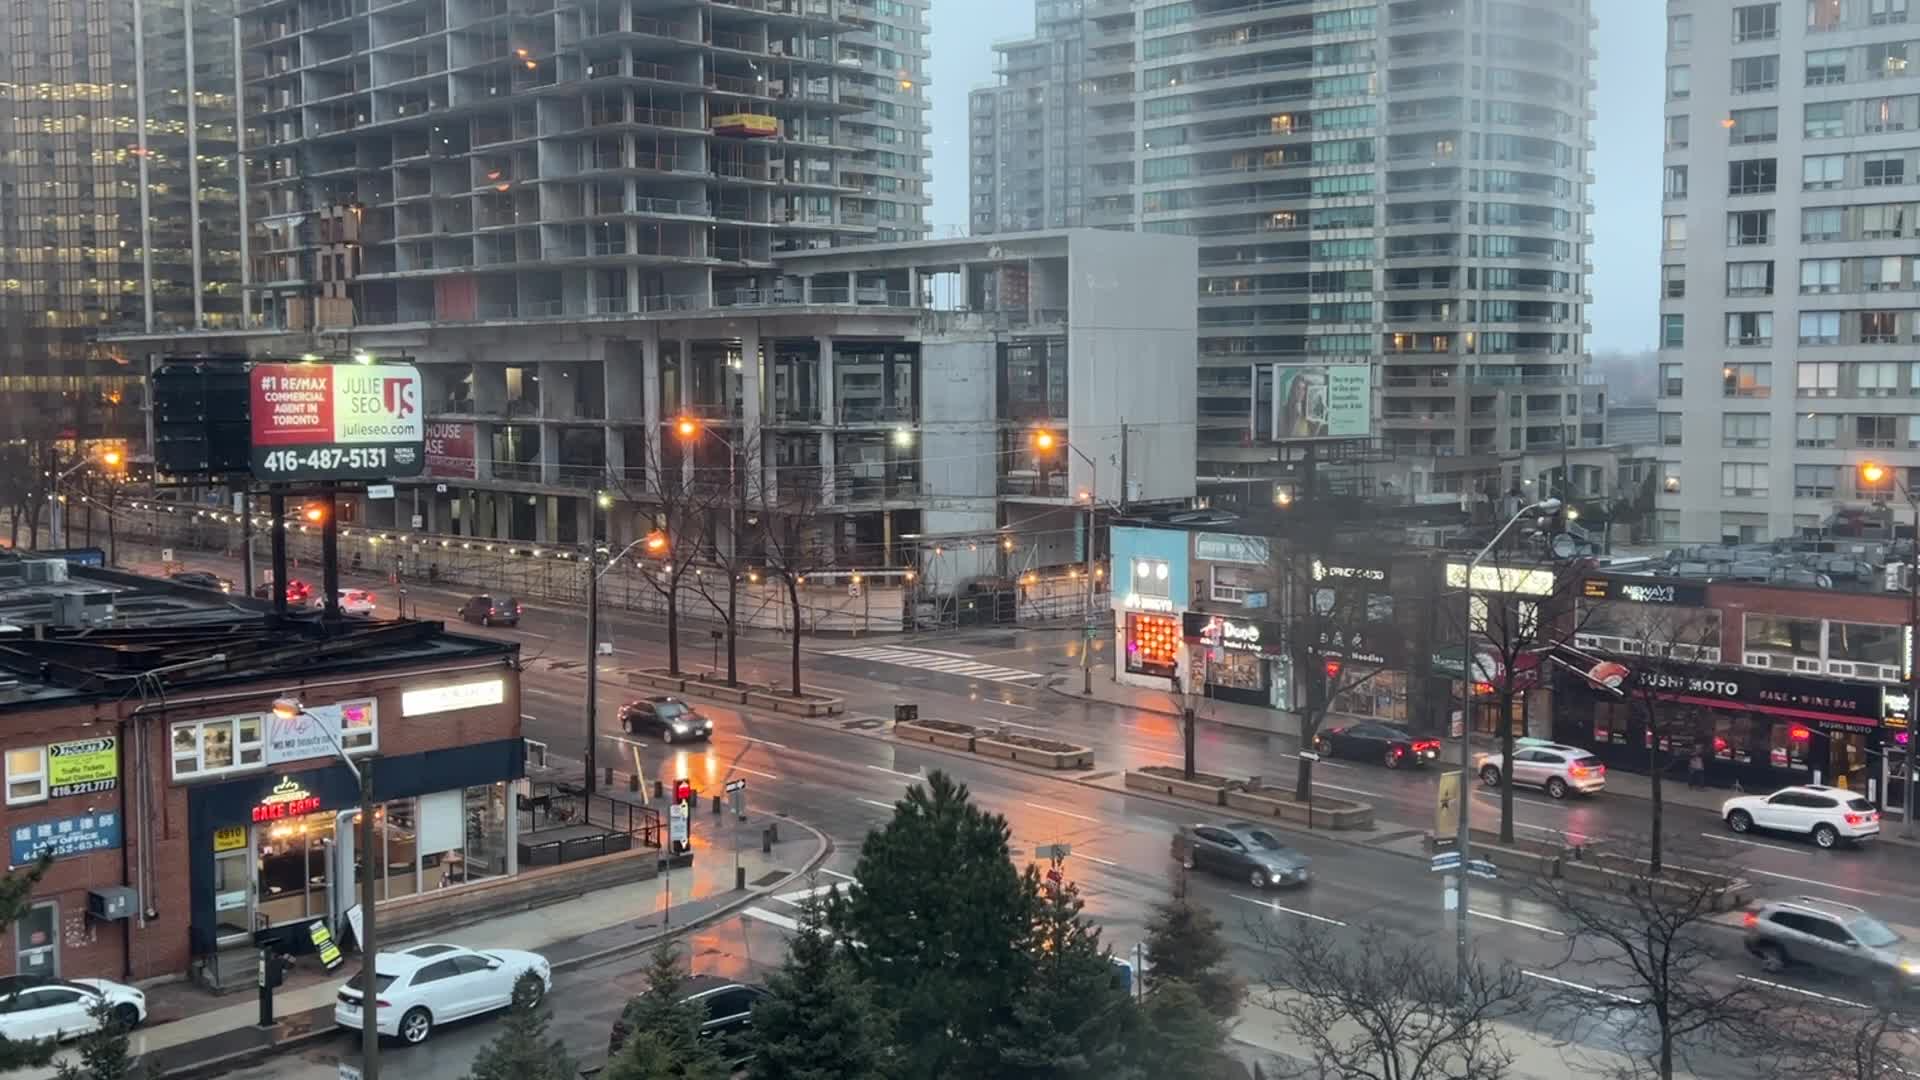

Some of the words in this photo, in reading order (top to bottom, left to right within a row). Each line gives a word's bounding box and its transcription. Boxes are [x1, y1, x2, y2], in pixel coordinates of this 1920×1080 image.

[261, 376, 276, 390] #1
[281, 377, 327, 390] RE/MAX
[342, 377, 380, 394] JULIE
[264, 391, 325, 402] COMMERCIAL
[351, 396, 382, 413] SEO
[274, 402, 305, 414] AGENT
[307, 403, 318, 413] IN
[272, 414, 320, 426] TORONTO
[343, 422, 415, 438] julieseo.com
[264, 447, 387, 473] 416-487-5131
[1688, 679, 1738, 696] MOTO
[1760, 690, 1789, 702] SAKE
[1801, 695, 1831, 706] WINE
[1833, 699, 1857, 709] BAR
[33, 838, 57, 849] LAW
[60, 832, 98, 844] OFFICE
[217, 827, 241, 839] 4910
